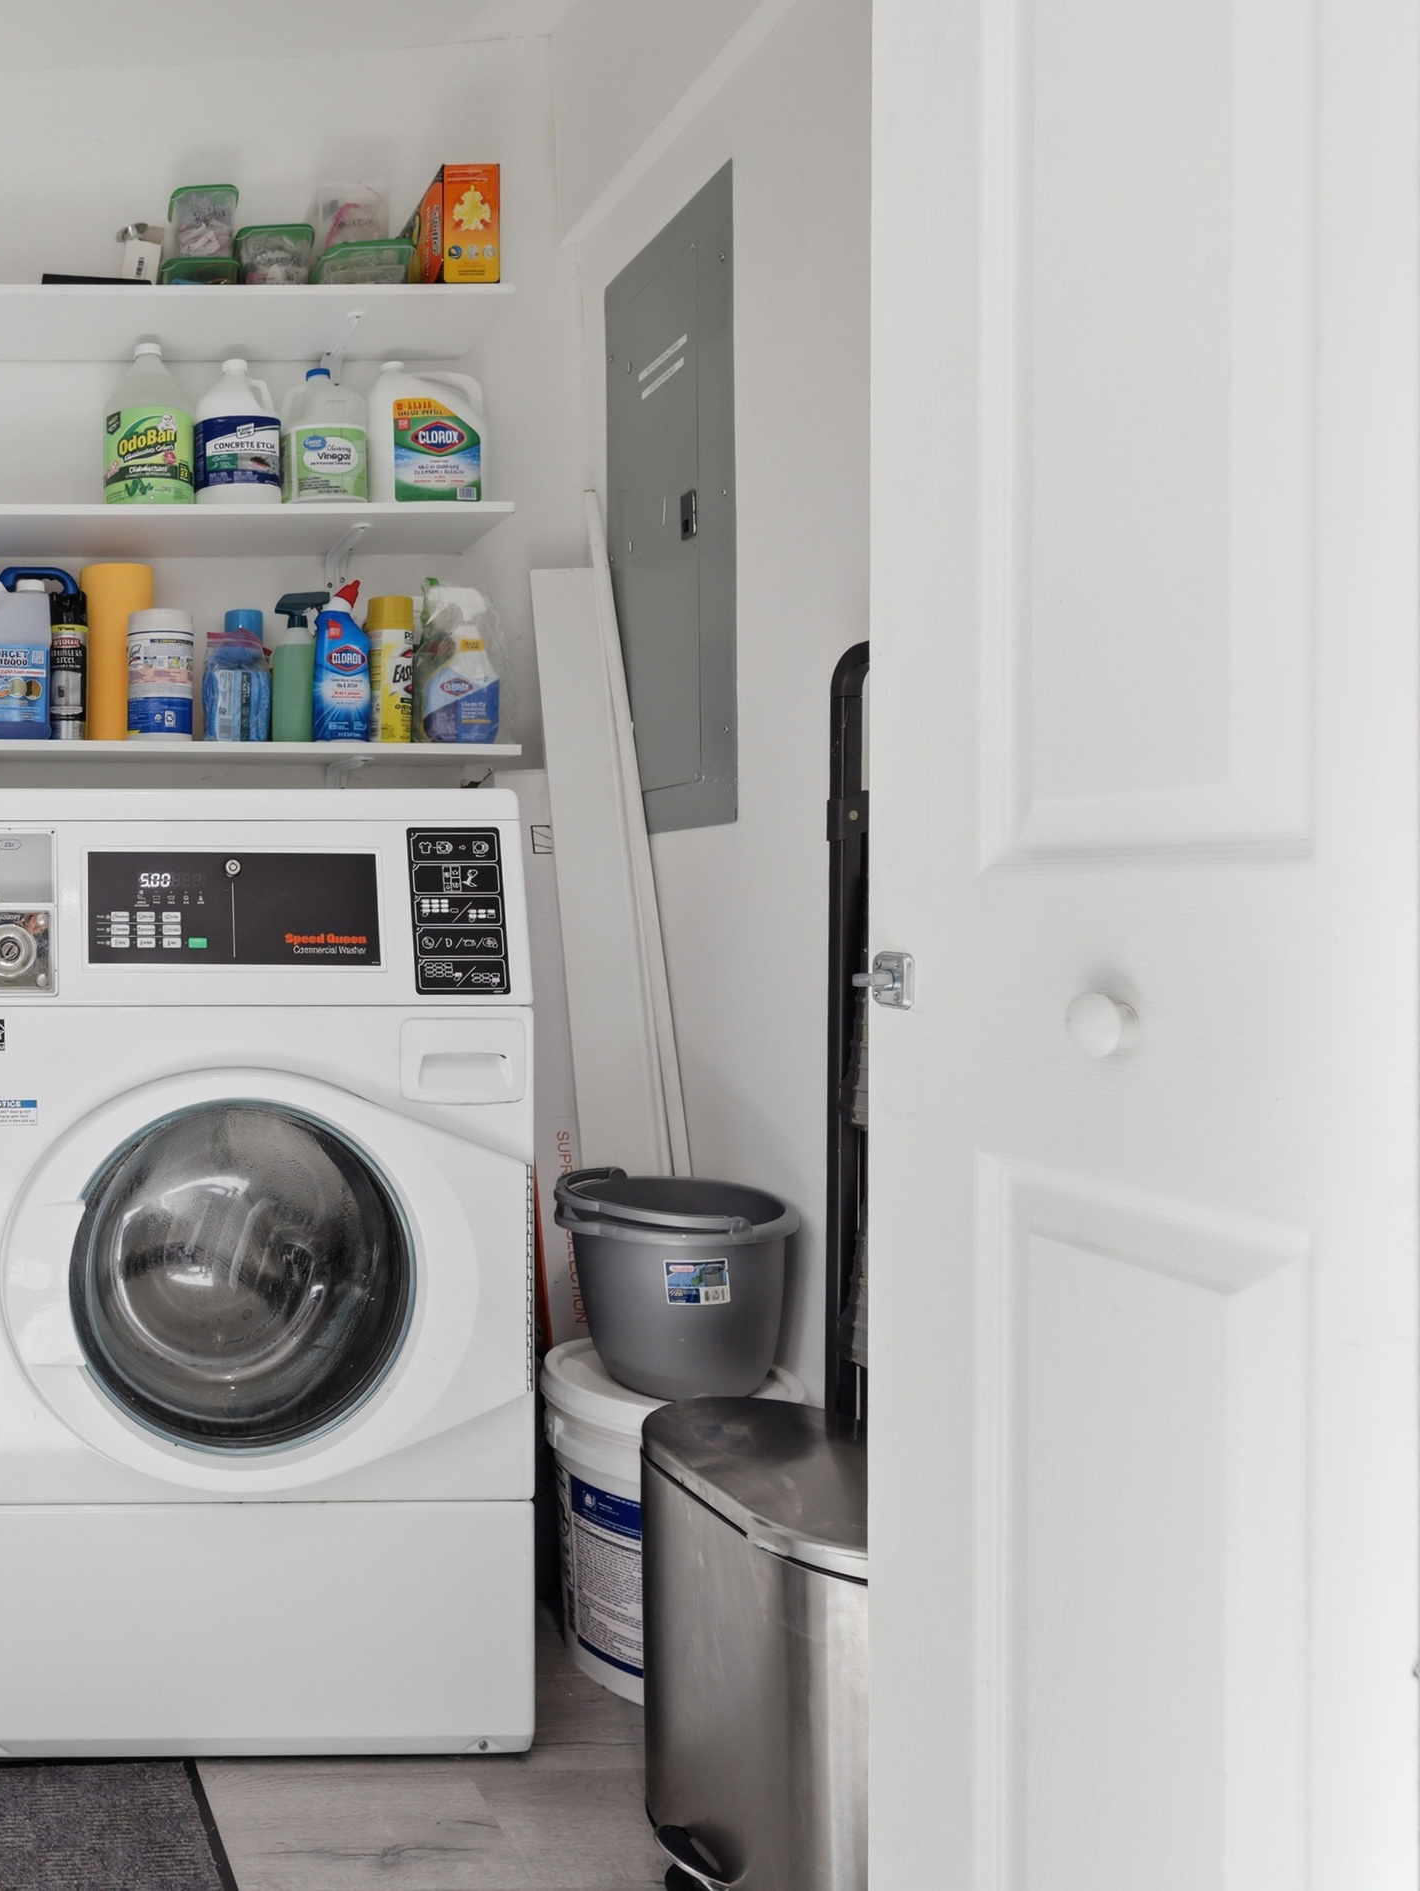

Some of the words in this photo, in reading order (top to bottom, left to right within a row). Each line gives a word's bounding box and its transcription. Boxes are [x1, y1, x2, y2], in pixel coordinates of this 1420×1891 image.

[119, 429, 175, 456] OdoBan
[418, 430, 459, 444] CLOROX
[214, 441, 255, 450] CONCRETE
[256, 441, 275, 450] ETCH
[317, 452, 351, 462] Vinegar
[140, 873, 171, 888] 5.00
[285, 933, 325, 946] Speed
[326, 933, 367, 944] Queen
[293, 945, 337, 954] Commercial
[338, 945, 367, 954] Washer
